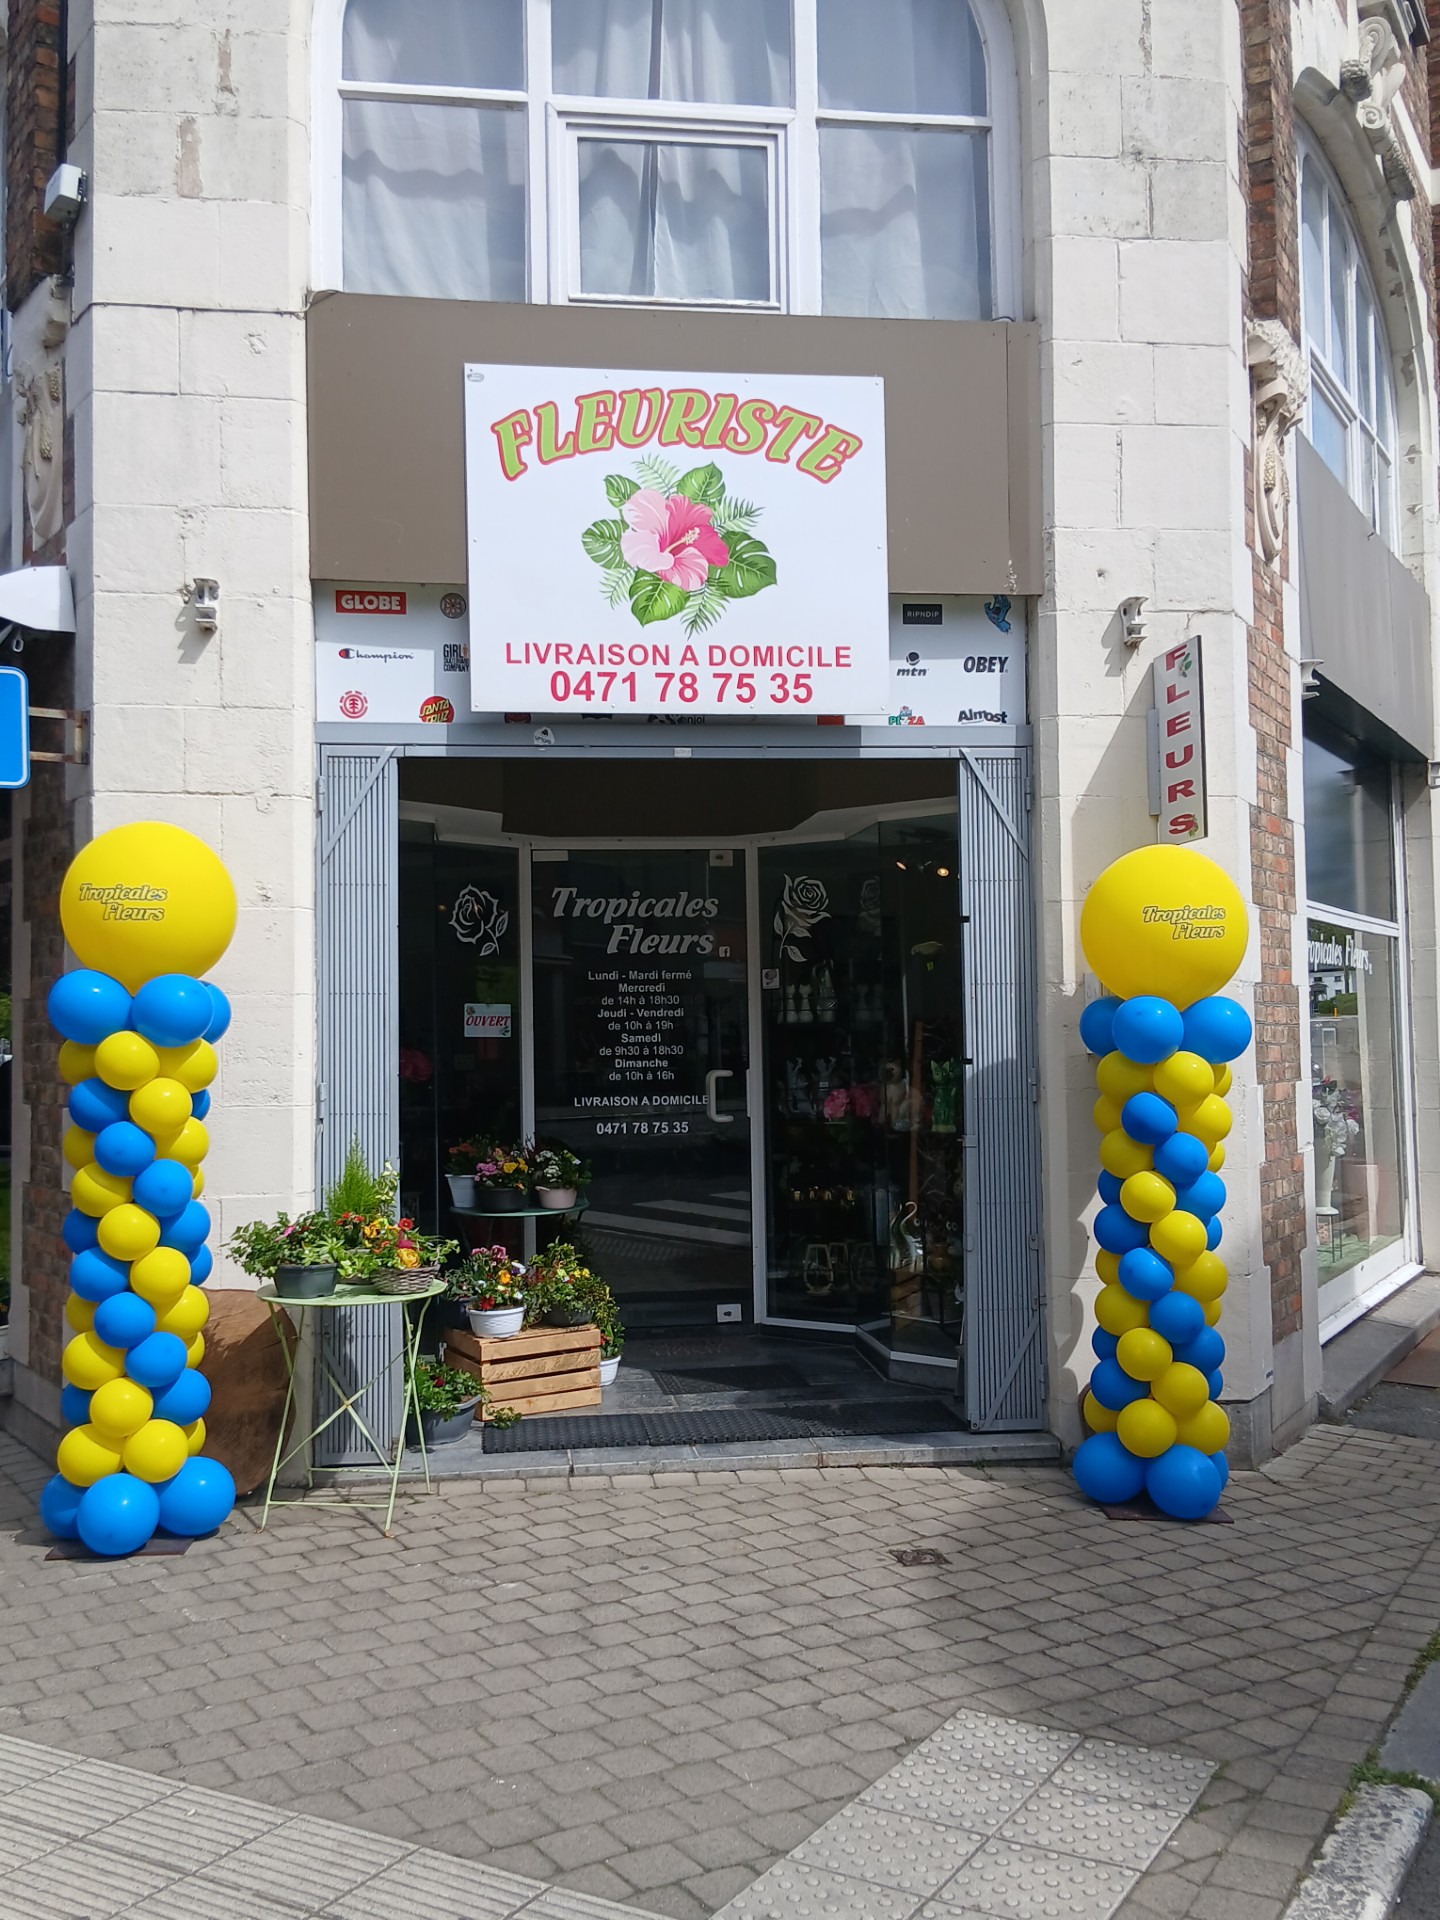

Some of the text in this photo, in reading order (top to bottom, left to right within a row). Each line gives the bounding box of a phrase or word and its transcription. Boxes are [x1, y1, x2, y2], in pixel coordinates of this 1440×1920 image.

[491, 387, 863, 483] FLEURISTE
[341, 594, 402, 610] GLOBE
[338, 648, 414, 663] Champion
[443, 644, 463, 658] GIRL
[506, 642, 852, 667] LIVRAISON A DOMICILE
[896, 667, 927, 676] mtn
[963, 656, 1008, 673] OBEY
[550, 671, 813, 703] 0471 78 75 35
[958, 708, 1007, 723] Almost
[1165, 644, 1195, 835] FLEURS
[80, 883, 167, 903] Tropicales
[103, 902, 164, 920] Fleurs
[552, 887, 720, 924] Tropicales
[1143, 905, 1225, 924] Tropicales
[1173, 922, 1224, 940] Fleurs
[607, 925, 714, 955] Fleurs
[1346, 934, 1369, 970] Fleurs
[588, 970, 618, 980] Lundi
[629, 970, 658, 980] Mardi
[661, 969, 692, 980] fermé
[618, 982, 665, 992] Mercredi
[601, 994, 680, 1005] de 14h à 18h30
[597, 1008, 626, 1018] Jeudi
[636, 1007, 684, 1017] Vendredi
[466, 1015, 511, 1027] OUVERT
[607, 1020, 674, 1030] de 10h à 19h
[621, 1032, 661, 1043] Samedi
[599, 1044, 684, 1056] de 9h30 à 18h30
[615, 1057, 669, 1068] Dimanche
[608, 1070, 674, 1081] de 10h à 16h
[574, 1094, 709, 1107] LIVRAISON A DOMICILE
[596, 1120, 689, 1134] 0471 78 75 35
